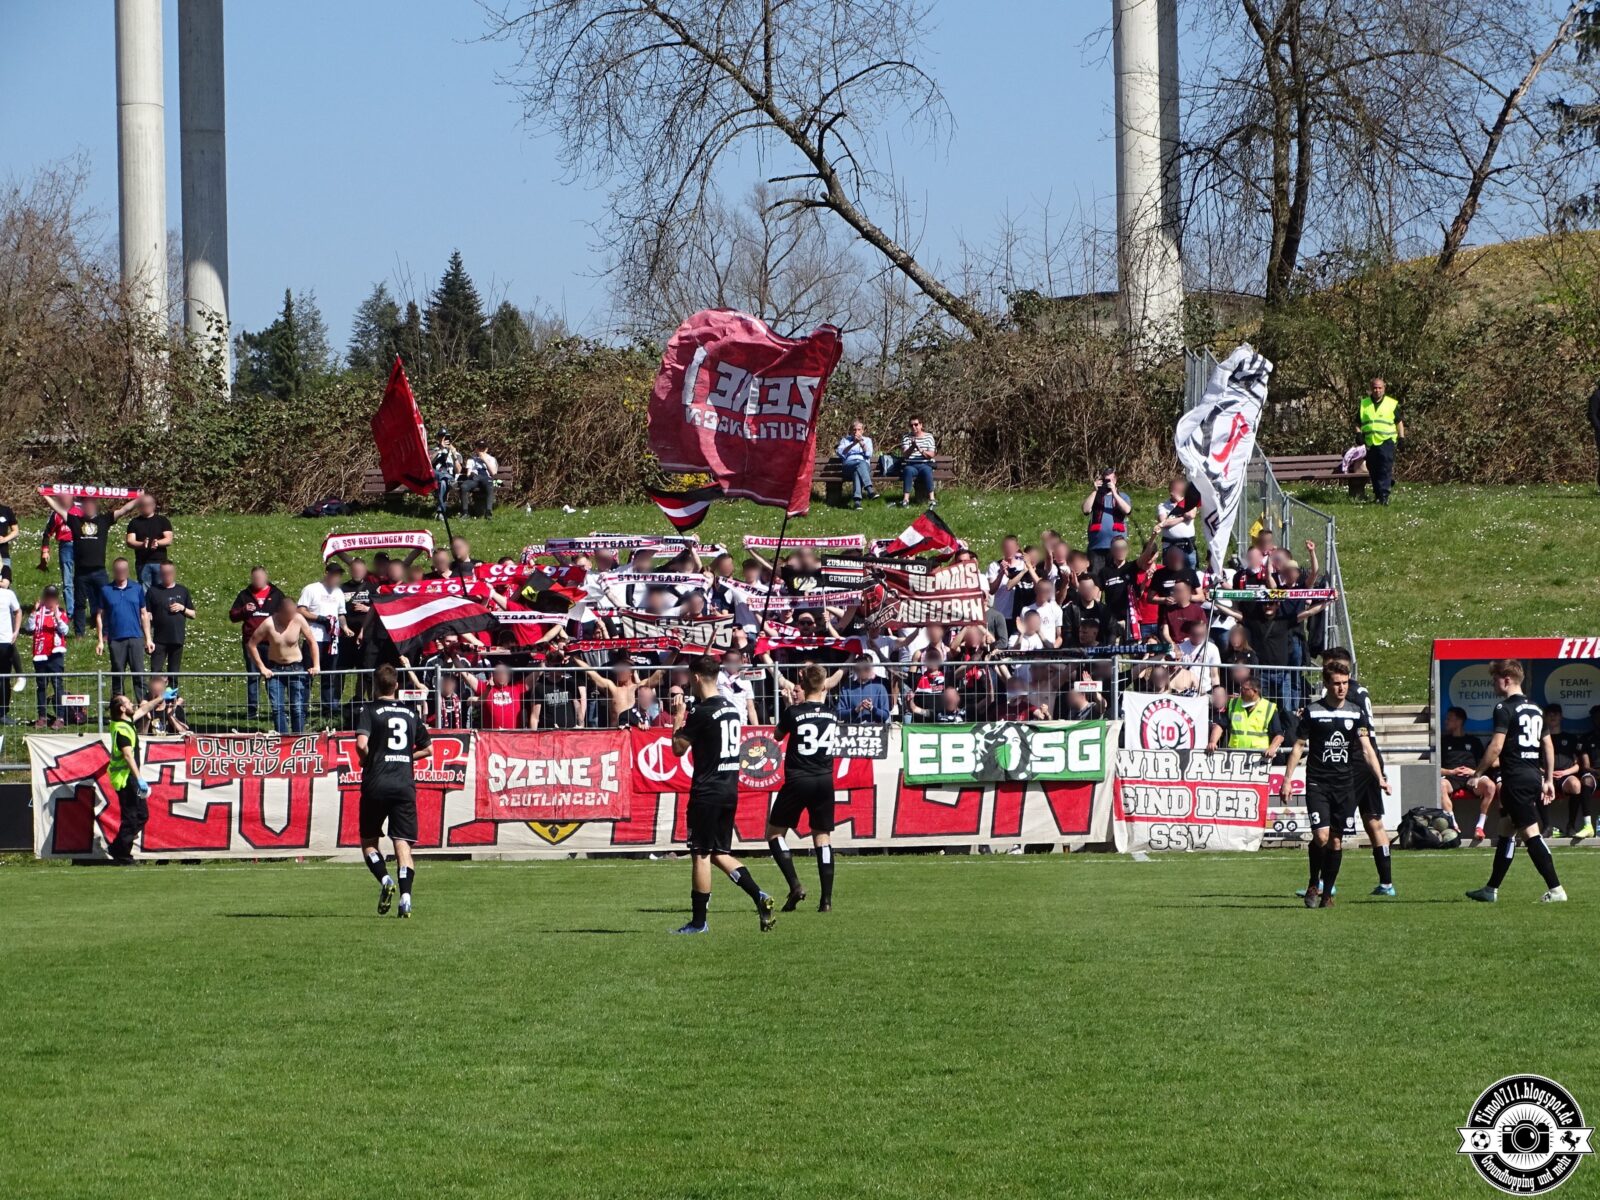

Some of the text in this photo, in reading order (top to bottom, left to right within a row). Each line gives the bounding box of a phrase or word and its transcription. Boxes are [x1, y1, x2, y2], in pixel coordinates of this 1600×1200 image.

[53, 484, 128, 496] SEIT 1905
[342, 539, 356, 547] SSV
[359, 536, 403, 545] REUTLINGEN
[568, 540, 642, 549] STUTTGART
[828, 538, 861, 546] KURVE
[489, 564, 518, 576] CC
[909, 562, 979, 592] NIEMALS
[393, 584, 422, 594] CC
[1560, 690, 1593, 699] SPIRIT
[387, 717, 408, 750] 3
[720, 719, 740, 758] 19
[797, 723, 837, 755] 34
[847, 726, 883, 737] BIST
[1518, 714, 1543, 748] 30
[197, 735, 281, 756] ONORE
[291, 735, 319, 755] AI
[847, 748, 882, 756] UNS!
[191, 755, 323, 775] DIFFIDATI
[488, 752, 592, 793] SZENE
[600, 751, 619, 792] E
[1116, 750, 1272, 783] WIR ALLE
[1121, 785, 1260, 820] SIND DER
[1149, 823, 1213, 850] SSV
